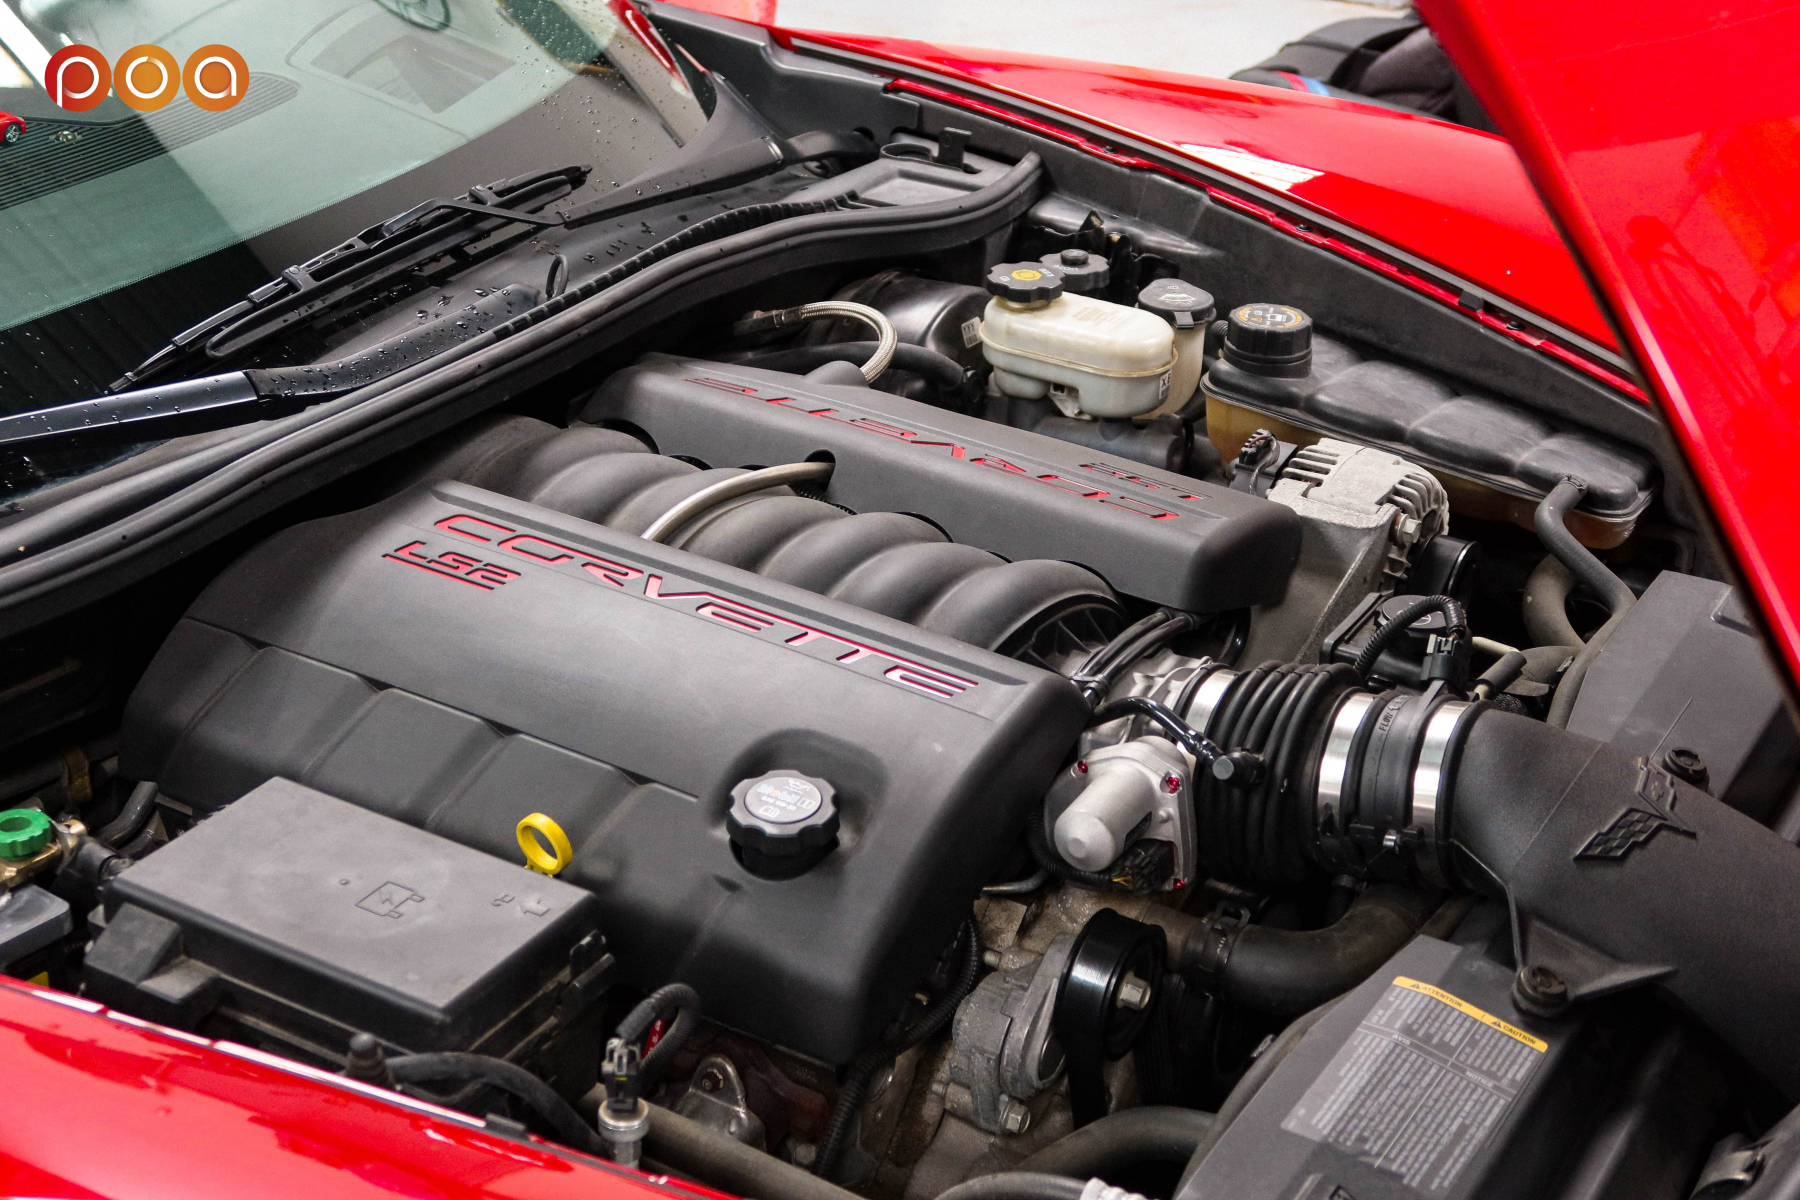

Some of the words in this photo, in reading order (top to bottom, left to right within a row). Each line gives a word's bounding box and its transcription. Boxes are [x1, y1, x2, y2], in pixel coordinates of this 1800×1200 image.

[394, 540, 522, 586] LS2
[433, 513, 979, 699] CORVETTE
[1422, 985, 1463, 1008] ATTENTION
[1503, 1025, 1536, 1045] CAUTION
